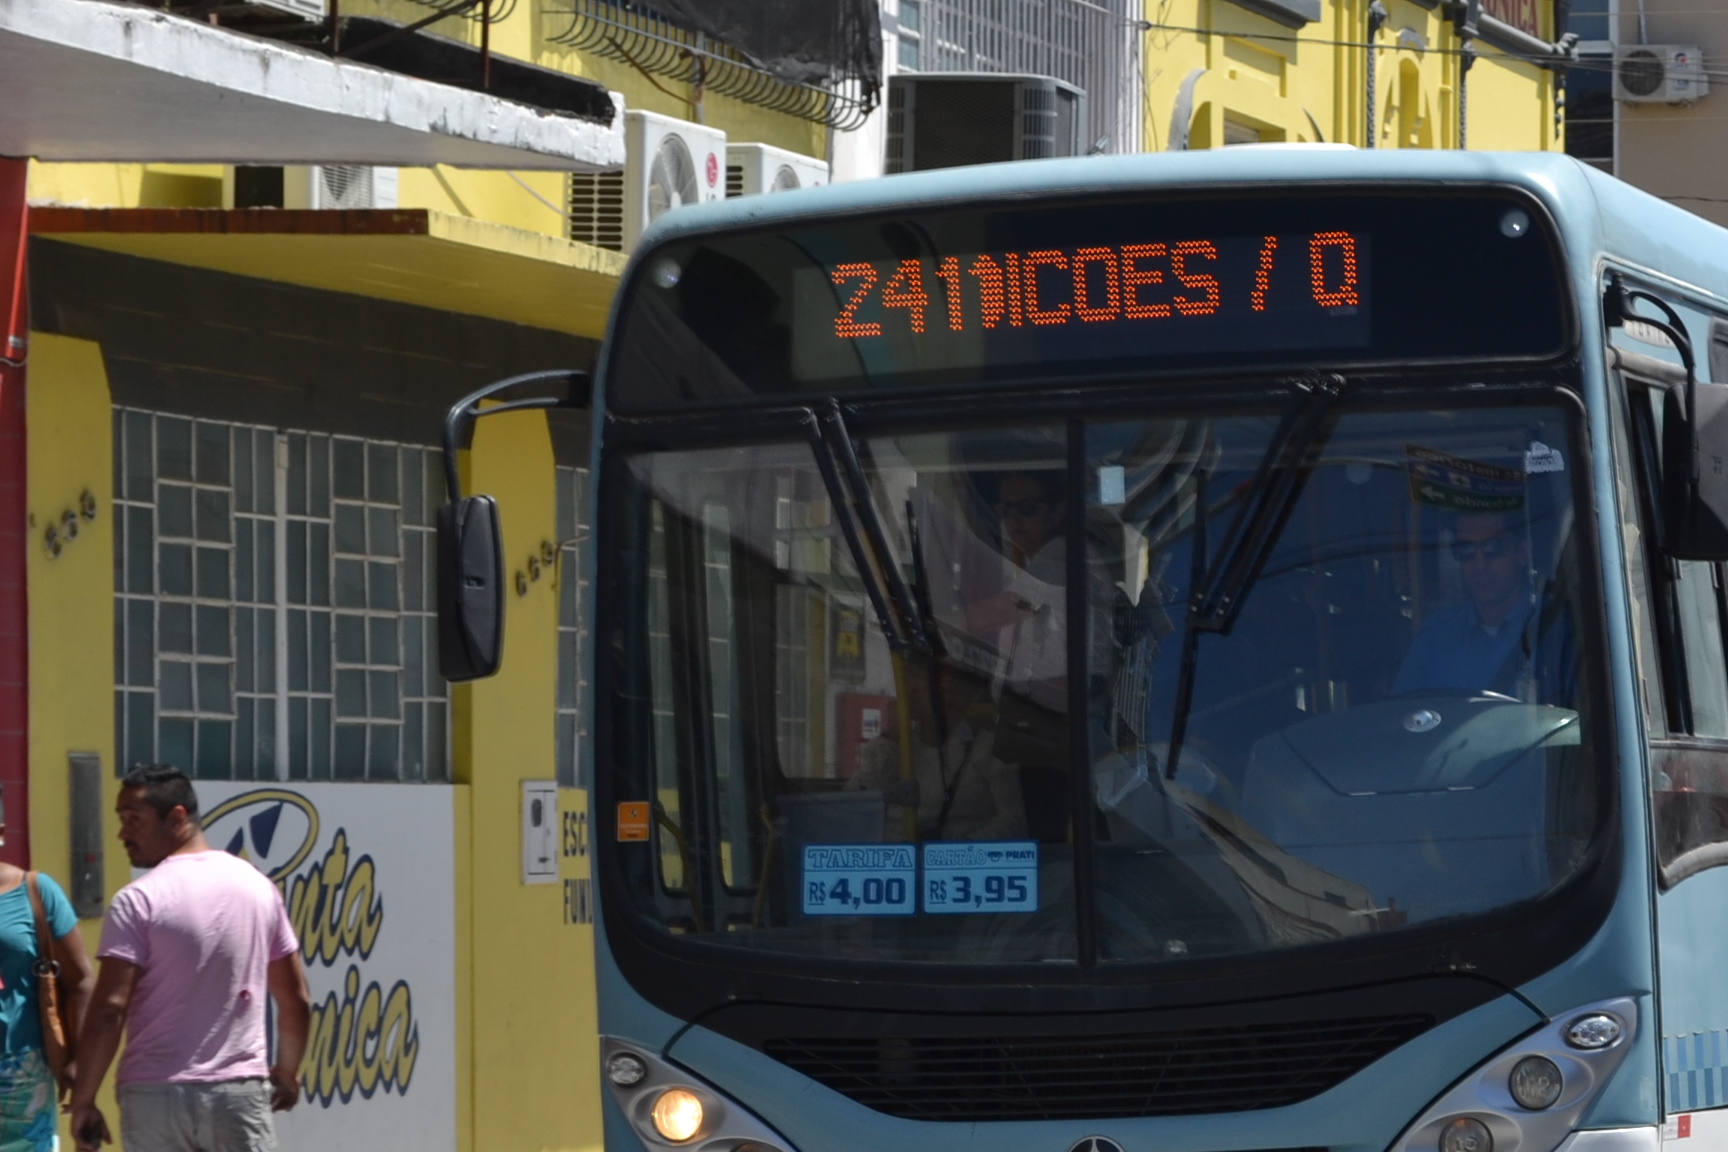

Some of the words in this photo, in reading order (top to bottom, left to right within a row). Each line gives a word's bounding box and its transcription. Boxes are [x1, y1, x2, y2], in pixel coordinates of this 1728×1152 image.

[1250, 235, 1277, 311] /
[1309, 231, 1359, 307] Q
[564, 811, 589, 857] ESC
[807, 848, 914, 869] TARIFA
[925, 846, 988, 866] CARTÃO
[808, 881, 826, 905] R$
[829, 878, 907, 910] 4,00
[930, 880, 948, 903] R$
[952, 875, 1028, 908] 3,95
